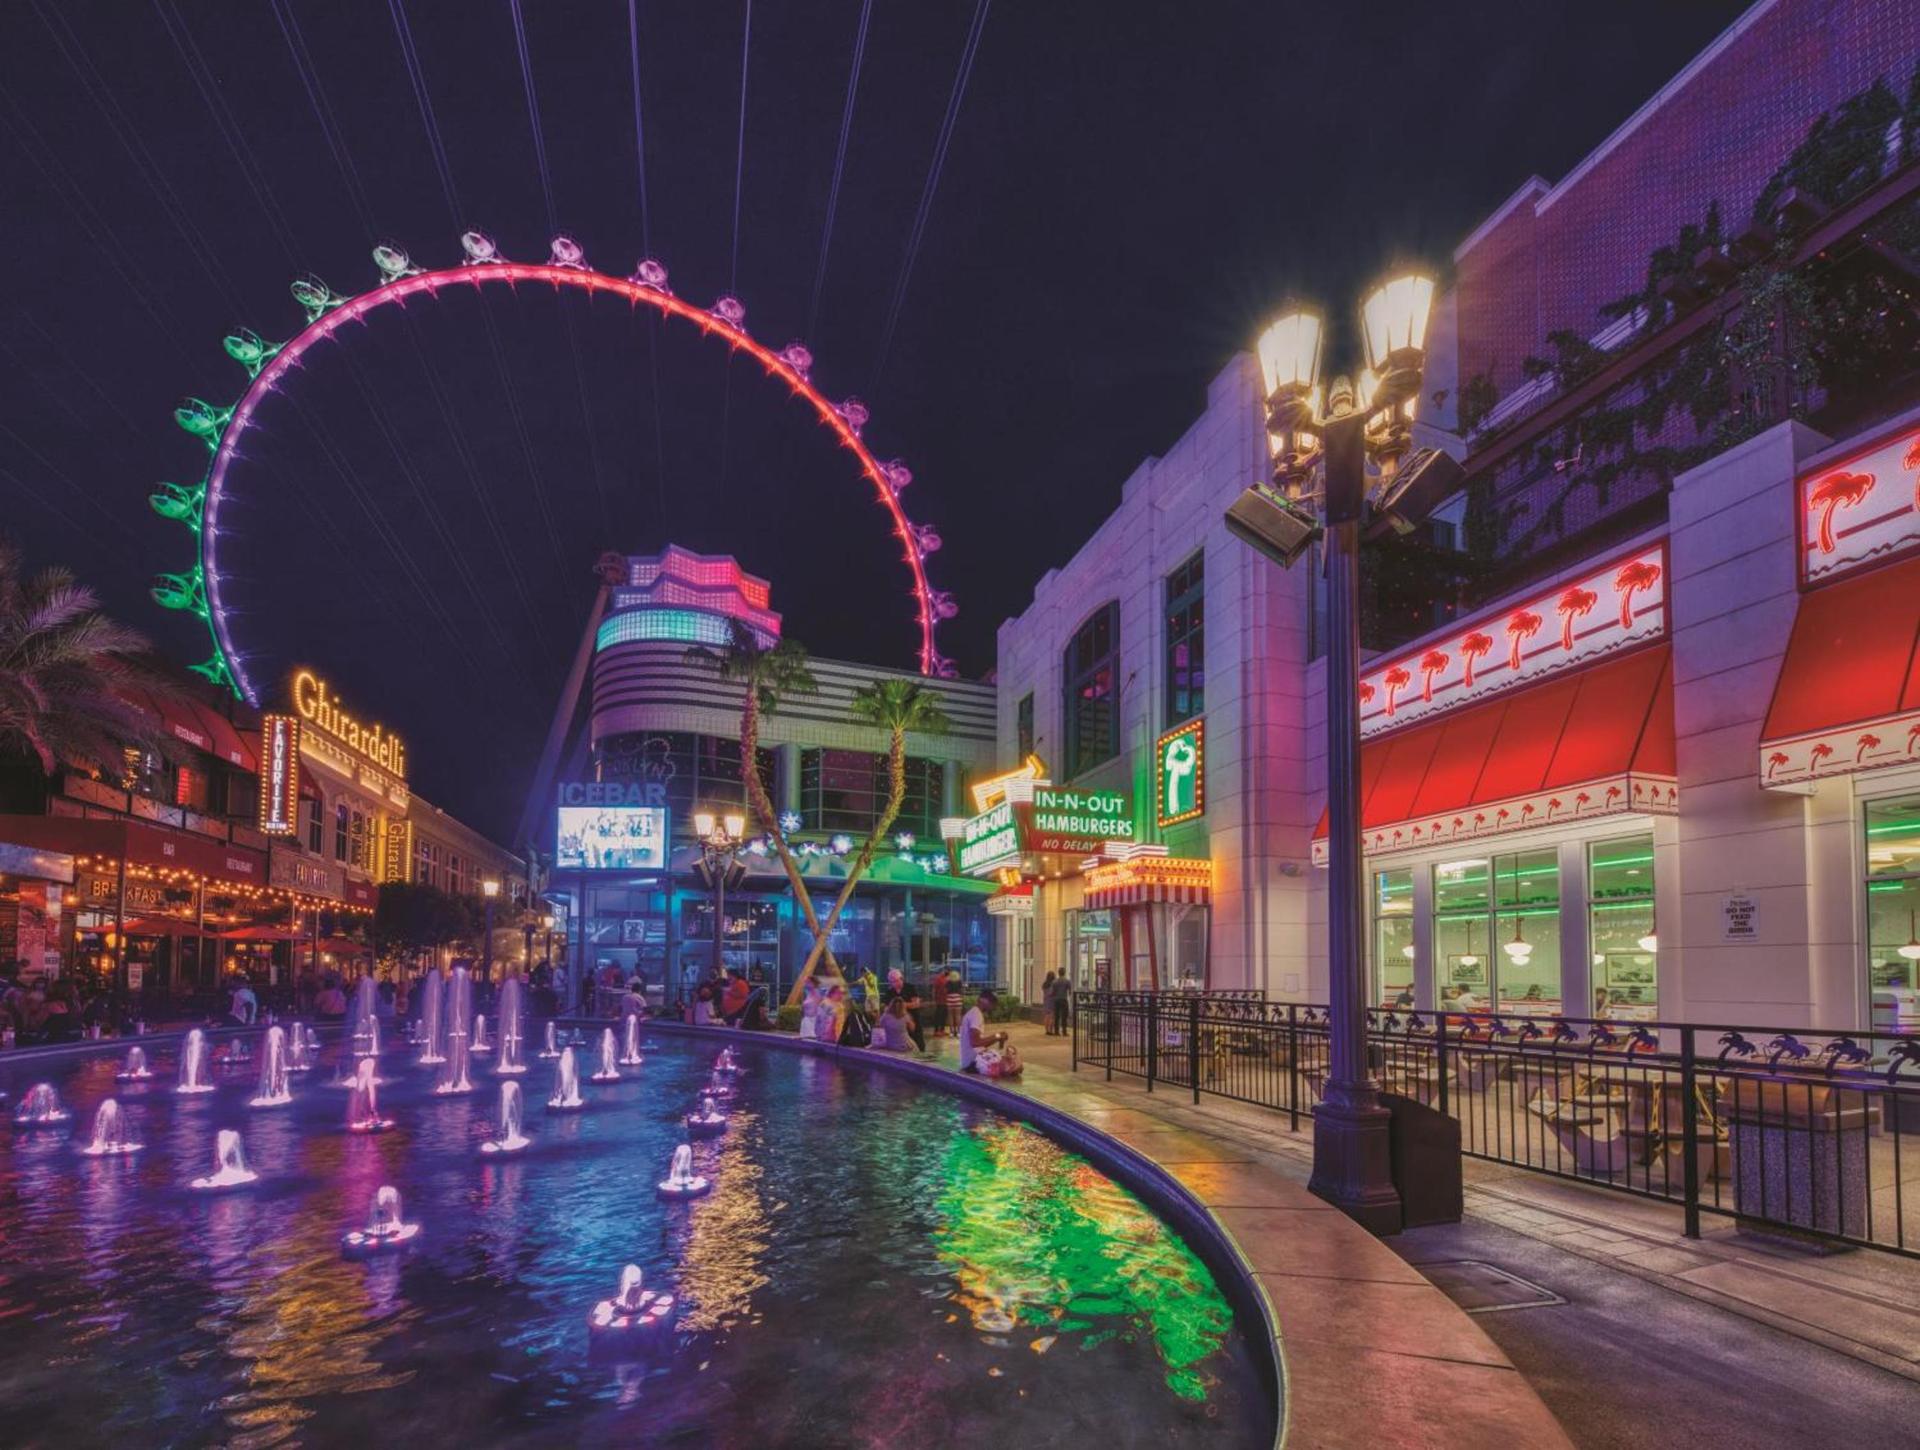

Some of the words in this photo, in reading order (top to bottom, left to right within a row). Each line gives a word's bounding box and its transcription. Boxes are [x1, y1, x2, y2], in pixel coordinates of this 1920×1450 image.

[294, 672, 405, 779] Ghirardelli
[271, 720, 285, 823] FAVORITE
[557, 783, 667, 804] ICEBAR
[1036, 790, 1124, 813] IN-N-OUT
[1036, 814, 1133, 837] HAMBURGERS
[1042, 838, 1059, 850] NO
[1063, 839, 1097, 852] DELAY
[93, 881, 161, 904] BREKFAST
